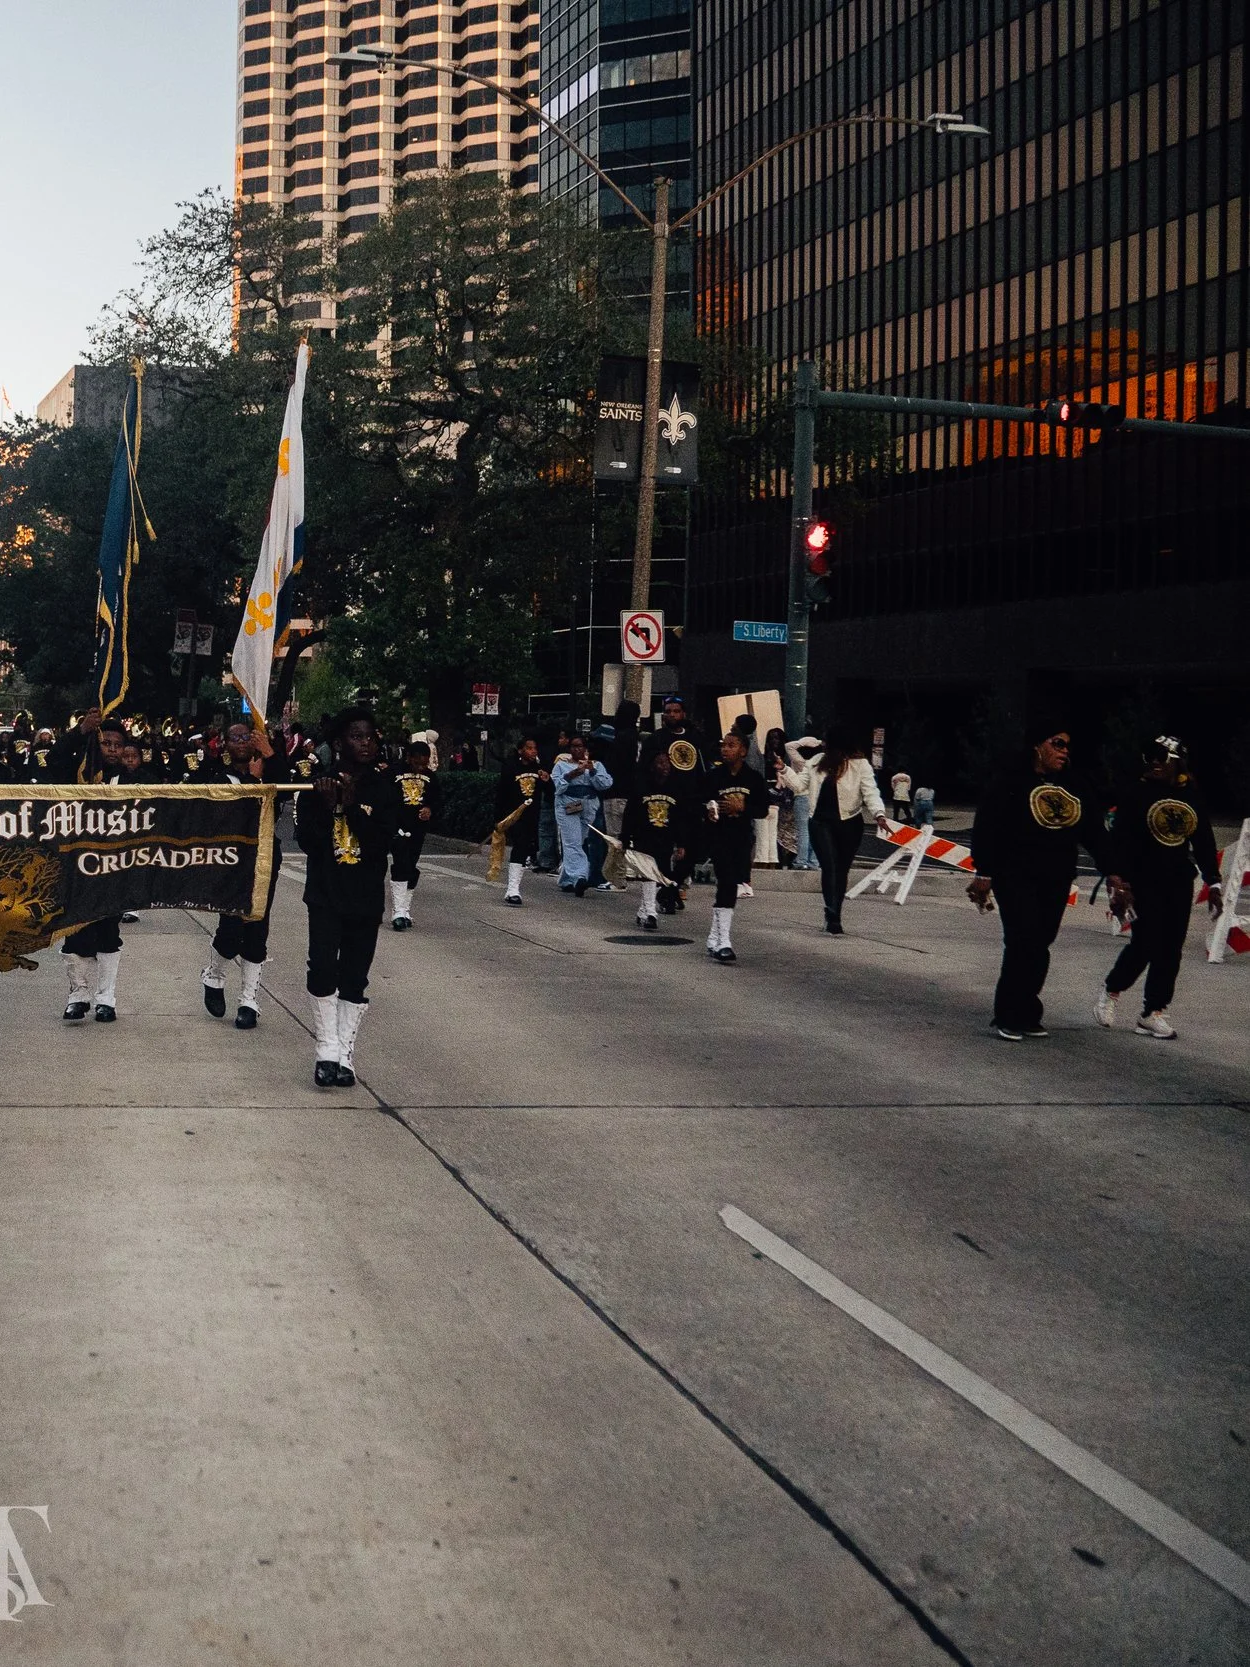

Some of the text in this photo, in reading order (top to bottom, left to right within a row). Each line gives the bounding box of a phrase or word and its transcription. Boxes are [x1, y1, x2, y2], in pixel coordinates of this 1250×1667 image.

[599, 407, 643, 421] SAINTS
[616, 402, 643, 410] ORLEANS
[753, 624, 785, 642] Liberty
[40, 799, 156, 841] Music
[77, 846, 239, 876] CRUSADERS
